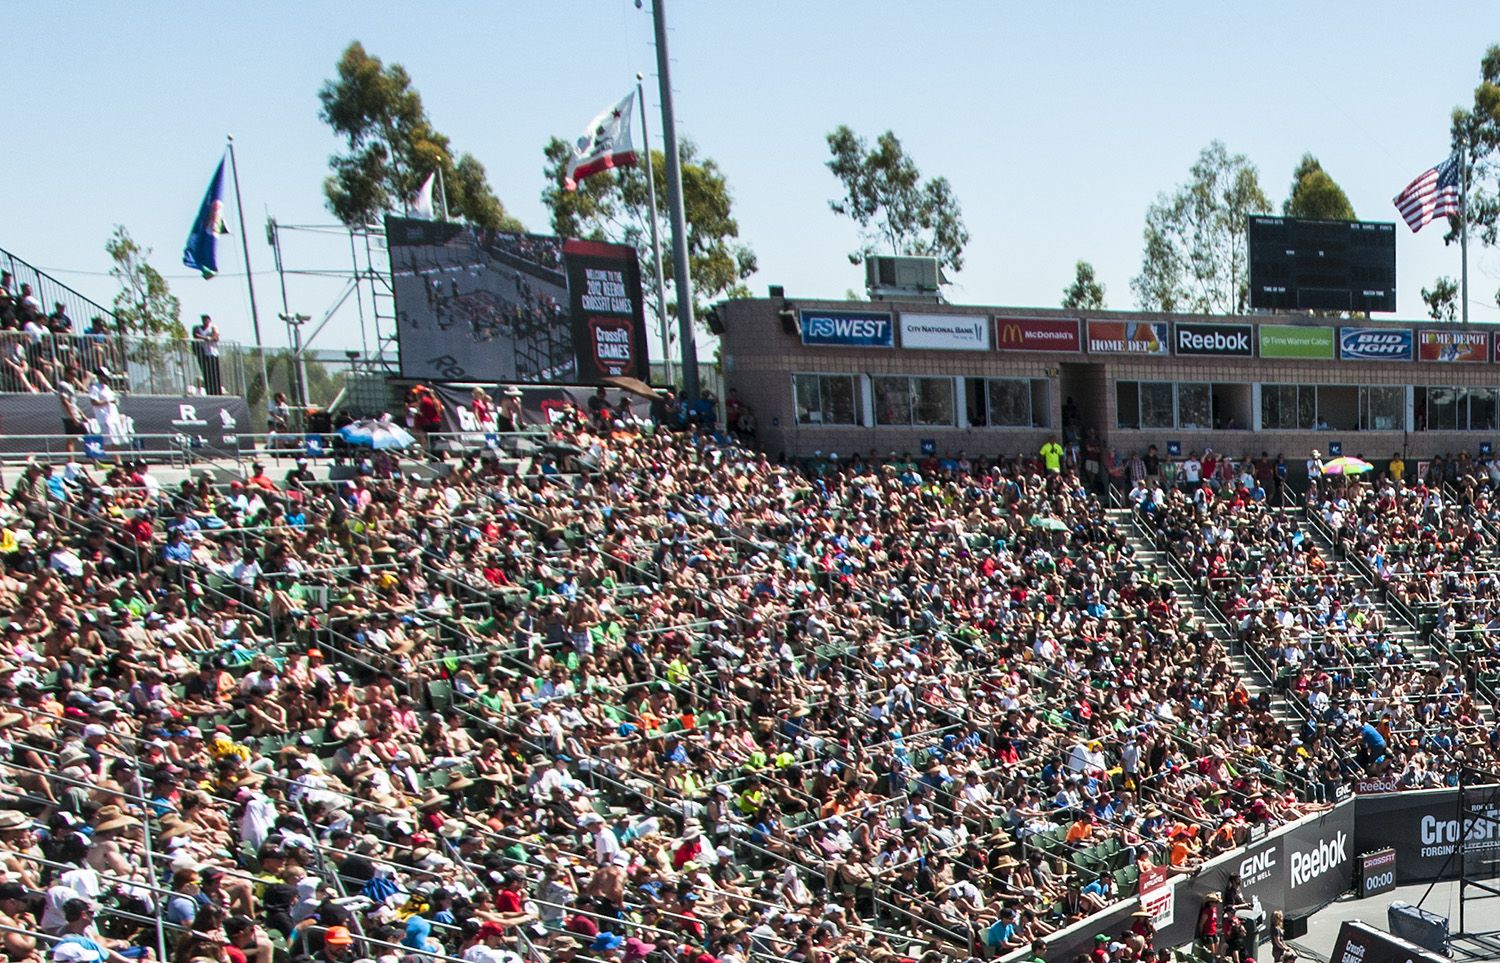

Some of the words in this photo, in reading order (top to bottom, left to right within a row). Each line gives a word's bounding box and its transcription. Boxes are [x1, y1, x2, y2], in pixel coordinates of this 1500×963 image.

[611, 297, 633, 314] GAMES
[595, 326, 629, 342] CrossFit
[1024, 329, 1074, 341] McDonald's
[1179, 331, 1248, 351] Reebok
[1357, 333, 1403, 344] BUD
[1421, 333, 1450, 345] HME
[1452, 333, 1487, 345] DEPOT
[597, 343, 630, 360] GAMES
[1127, 339, 1166, 353] DEPT
[1347, 343, 1410, 354] LIGHT
[1336, 782, 1351, 798] GNC
[1359, 779, 1399, 793] Reebok
[1239, 846, 1276, 880] GNC
[1291, 830, 1347, 889] Reebok
[1363, 853, 1396, 868] CROSSFIT
[1243, 878, 1256, 888] LIVE
[1257, 870, 1272, 881] WELL
[1366, 871, 1393, 890] 00:00
[1345, 939, 1366, 958] CrossFit
